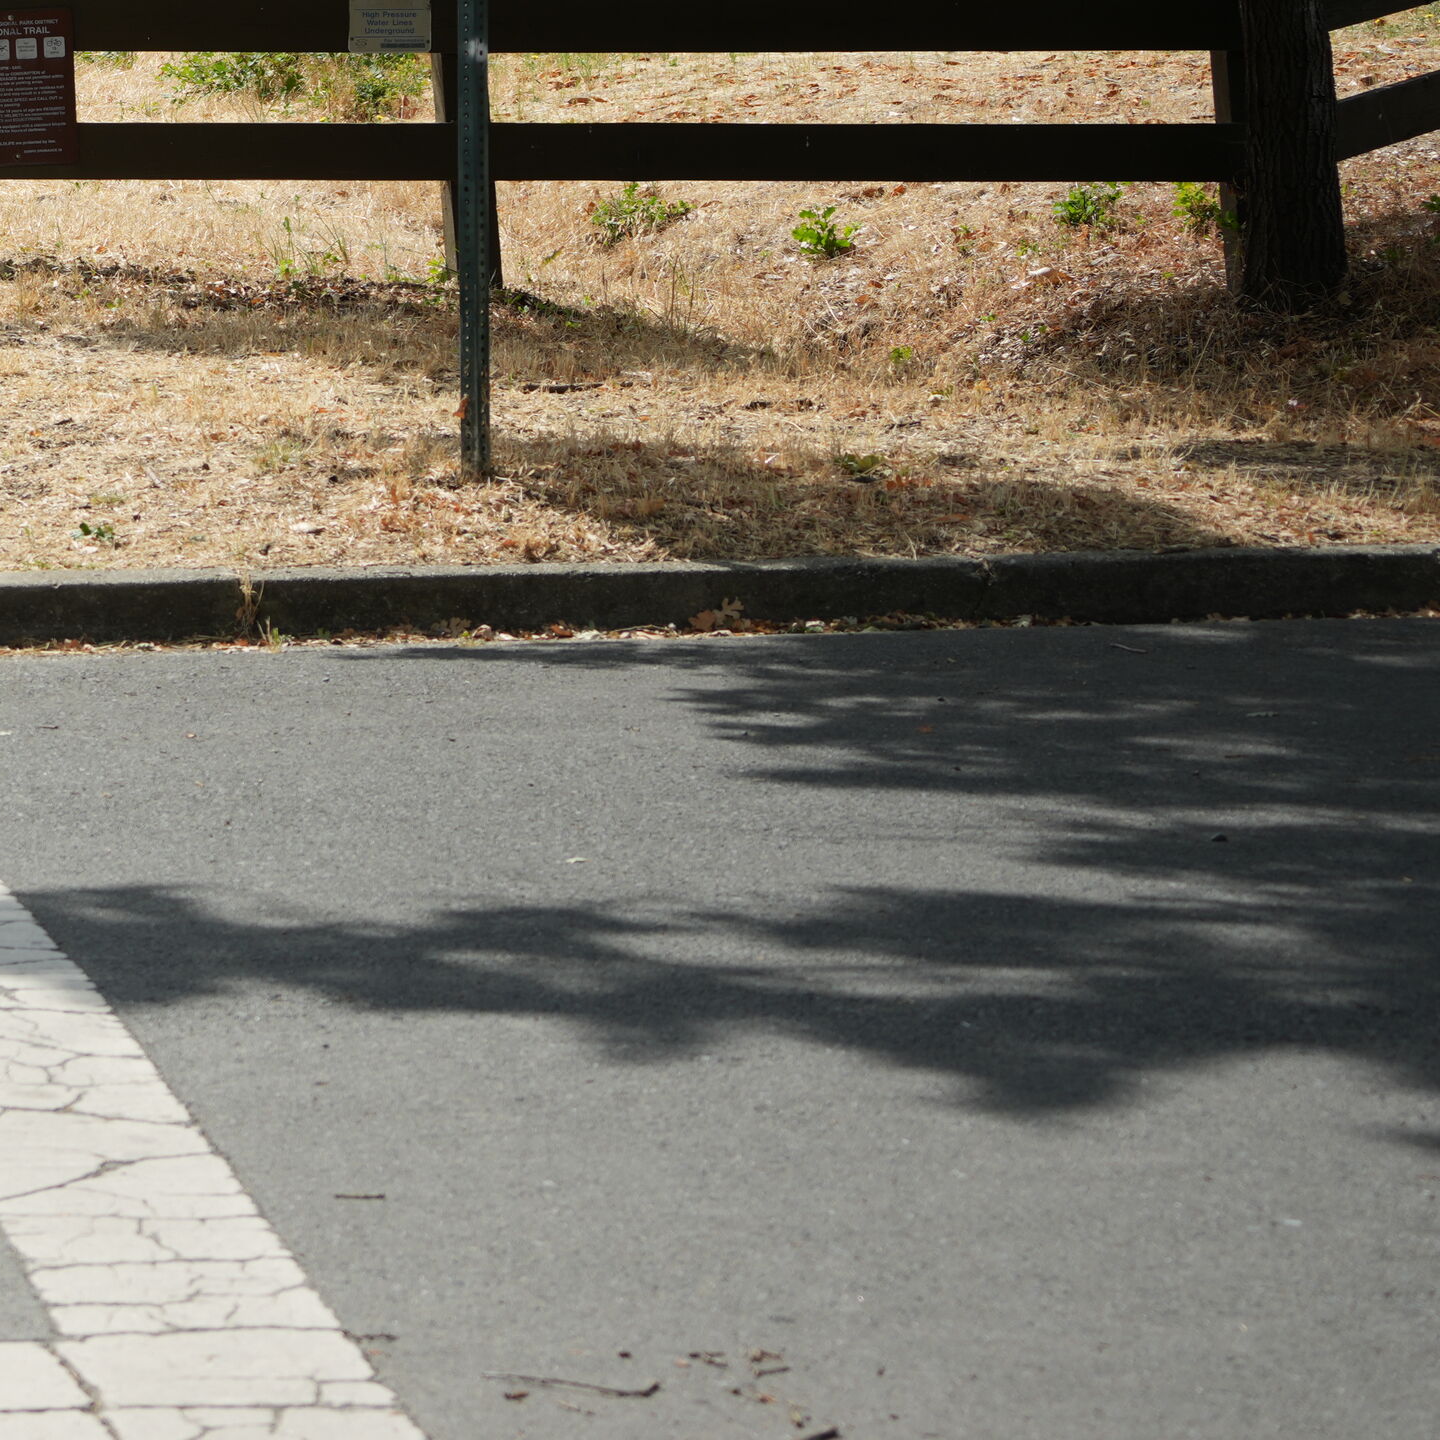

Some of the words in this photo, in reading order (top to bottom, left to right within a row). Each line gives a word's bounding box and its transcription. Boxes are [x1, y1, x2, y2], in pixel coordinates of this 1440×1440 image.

[362, 11, 380, 19] High
[23, 26, 51, 35] TRAIL
[364, 27, 415, 35] Underground
